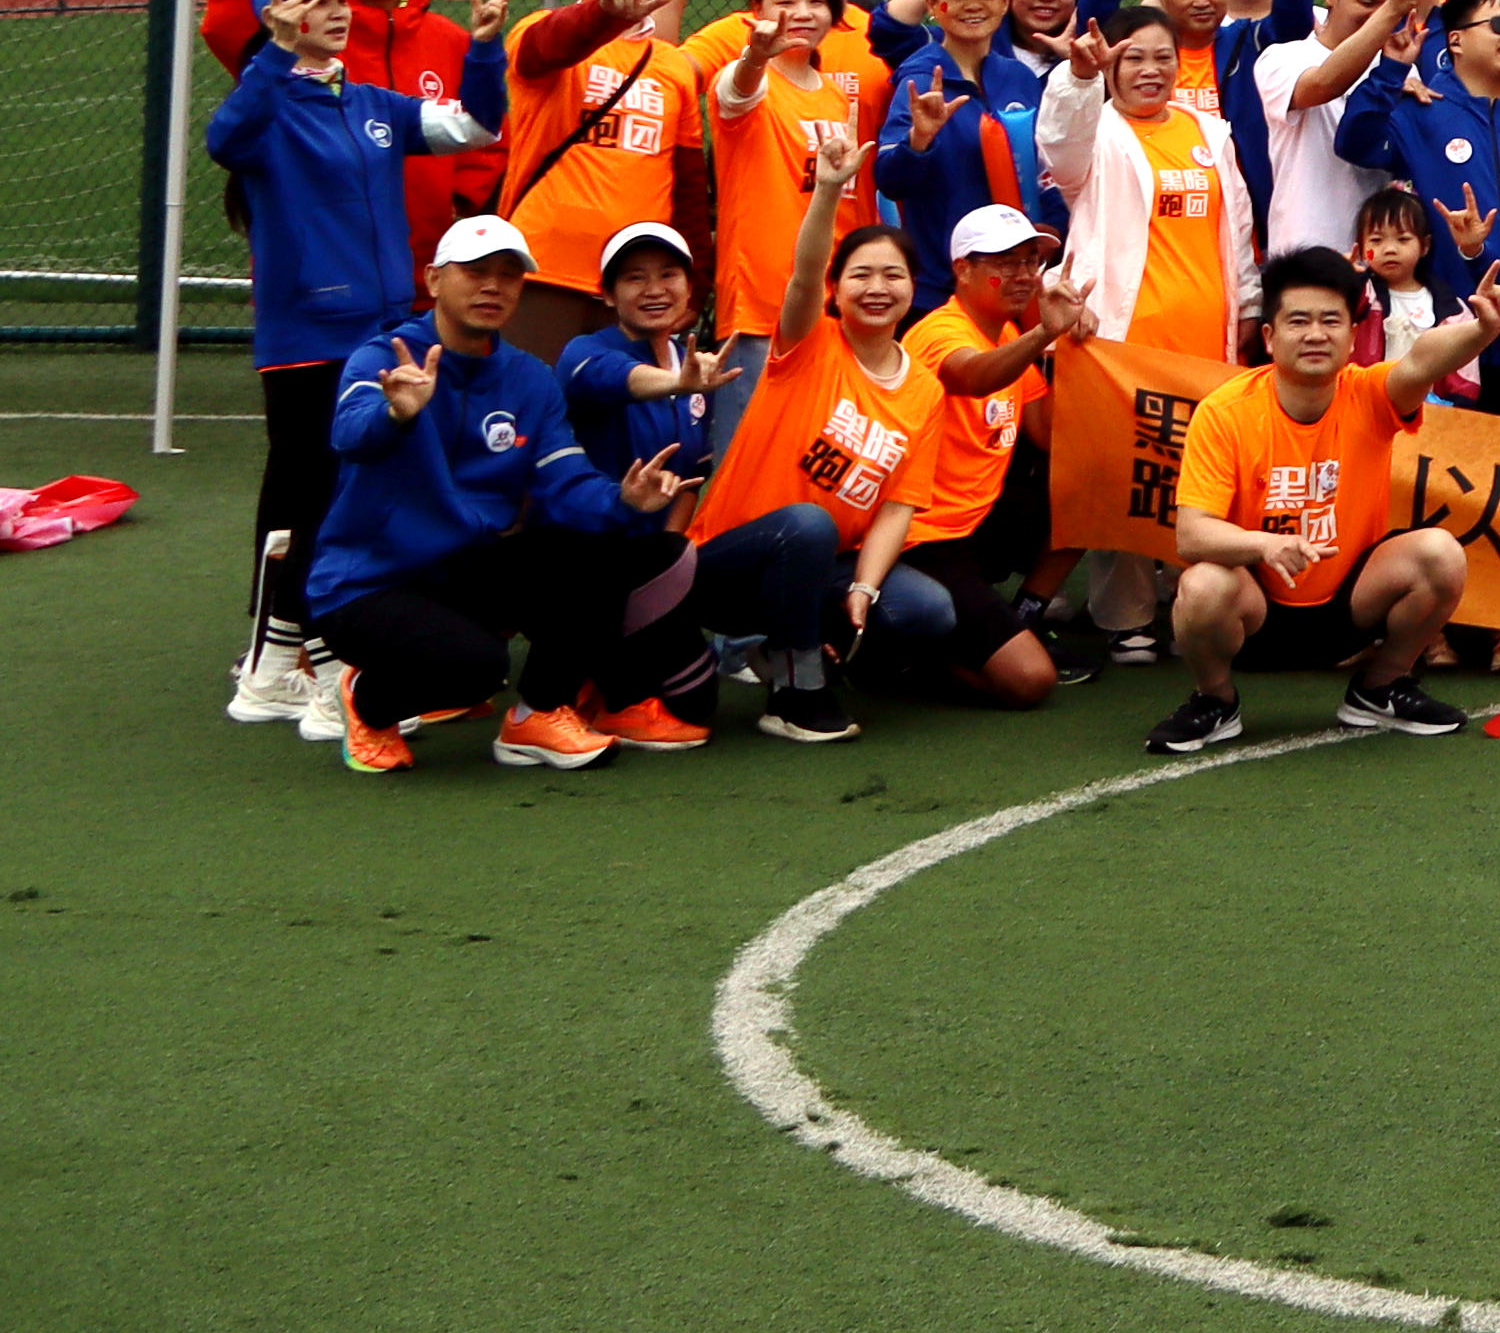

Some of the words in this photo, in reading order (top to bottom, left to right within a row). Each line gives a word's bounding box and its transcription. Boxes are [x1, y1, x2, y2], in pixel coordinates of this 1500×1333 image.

[1157, 192, 1209, 218] 跑团
[1158, 168, 1210, 193] 黑暗
[823, 398, 908, 474] 黑暗
[799, 438, 887, 510] 跑团
